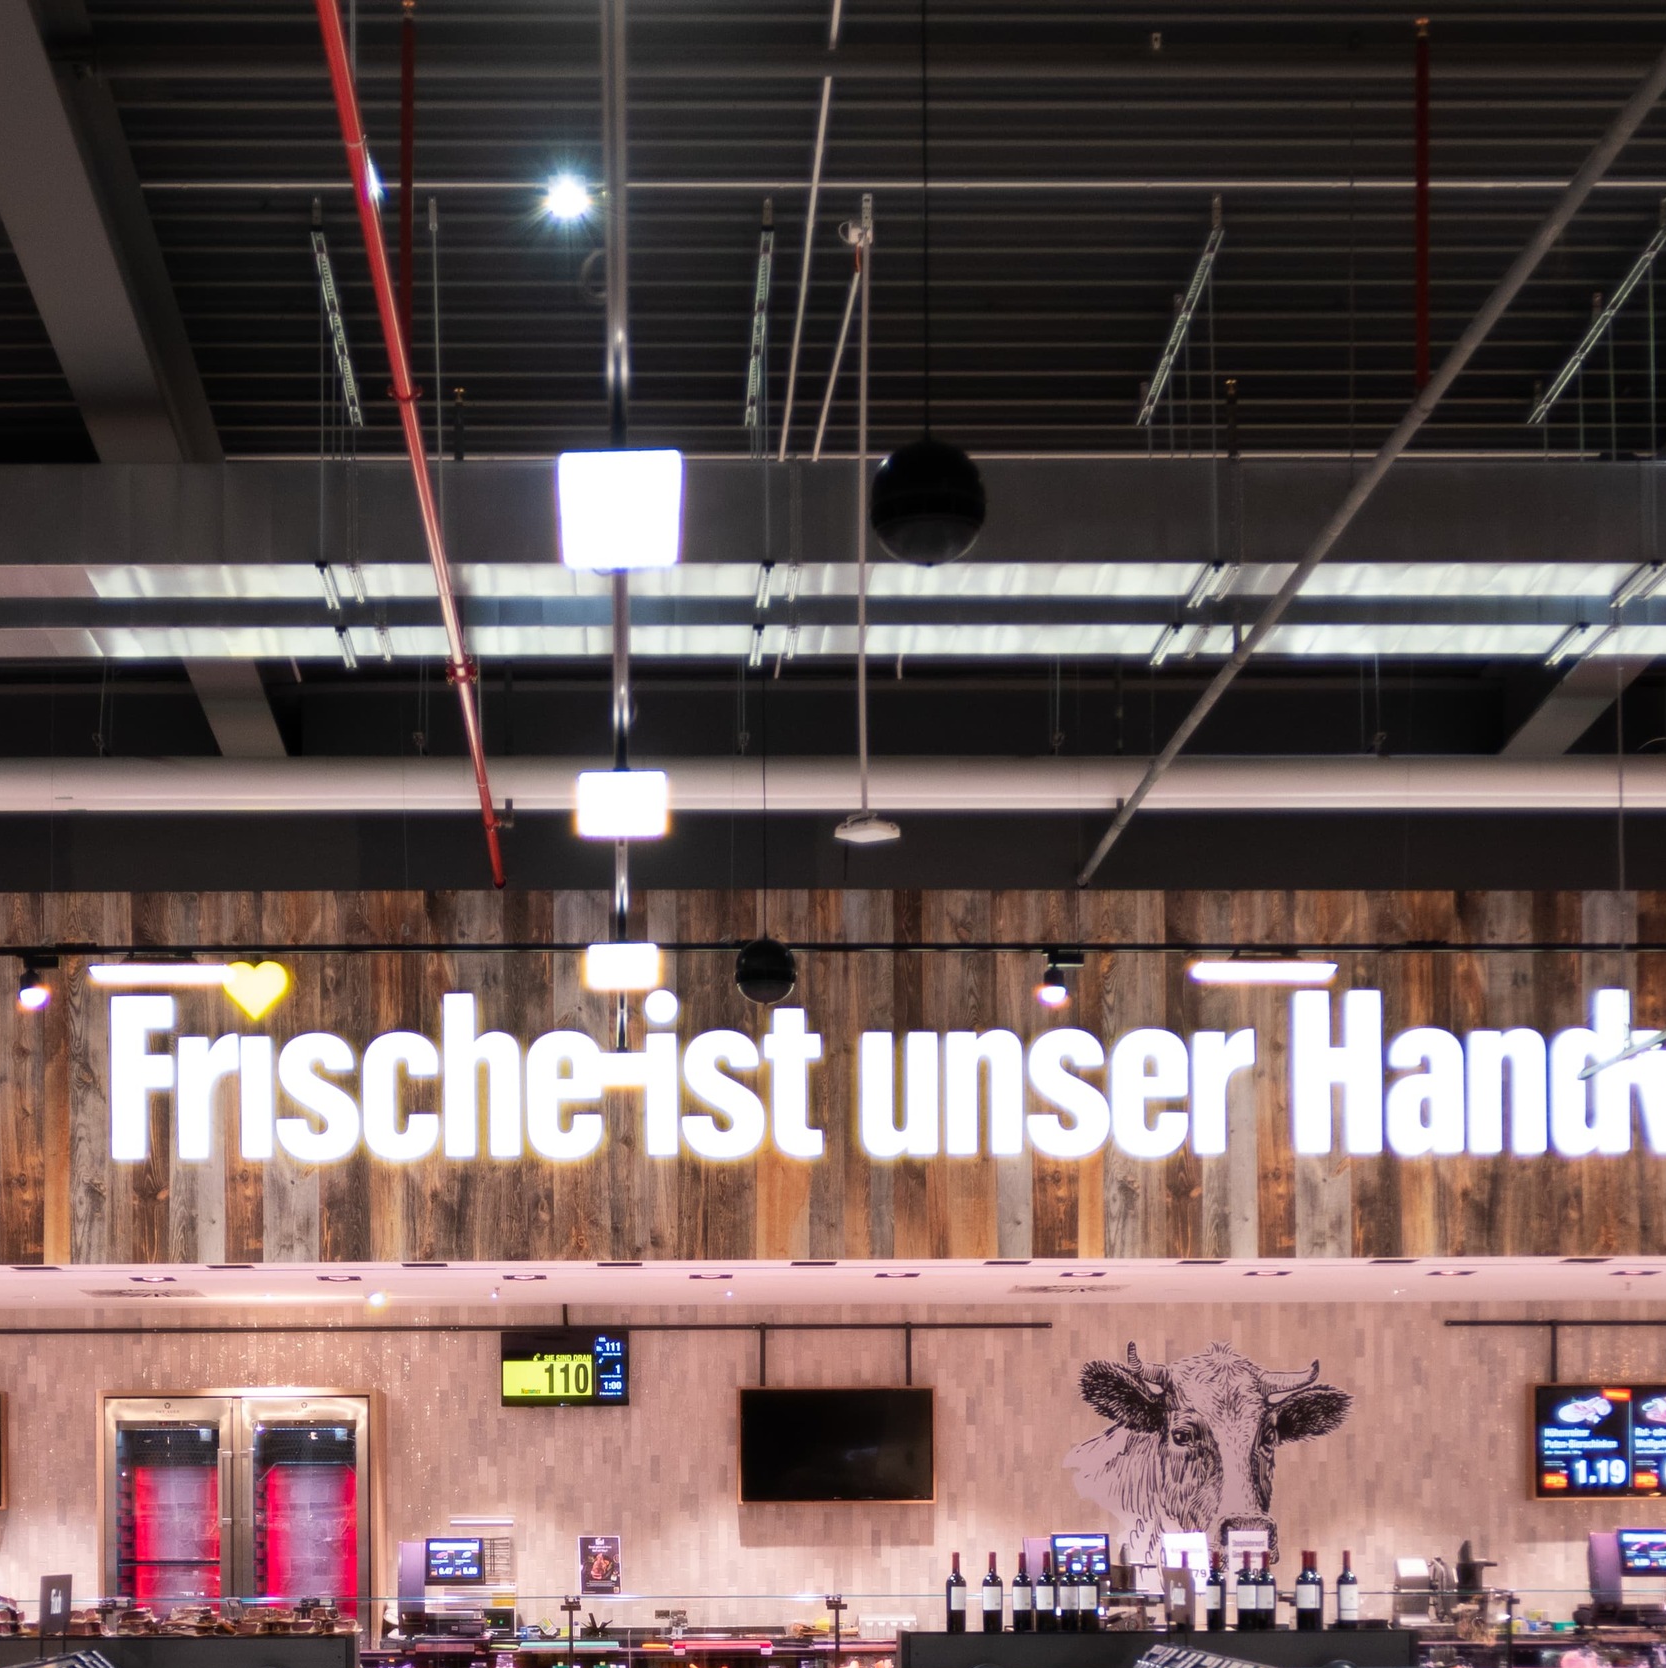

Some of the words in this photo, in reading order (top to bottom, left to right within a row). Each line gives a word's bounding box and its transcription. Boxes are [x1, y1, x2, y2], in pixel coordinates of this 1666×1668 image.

[110, 992, 604, 1162] Frische
[645, 989, 824, 1160] ist
[859, 1026, 1257, 1159] unser
[604, 1341, 621, 1352] 111
[543, 1354, 555, 1362] SIE
[555, 1354, 572, 1362] SIND
[573, 1354, 592, 1362] DRAN
[615, 1364, 621, 1374] 1
[544, 1363, 589, 1394] 110
[603, 1380, 622, 1390] 1:00
[1574, 1458, 1627, 1484] 1.19
